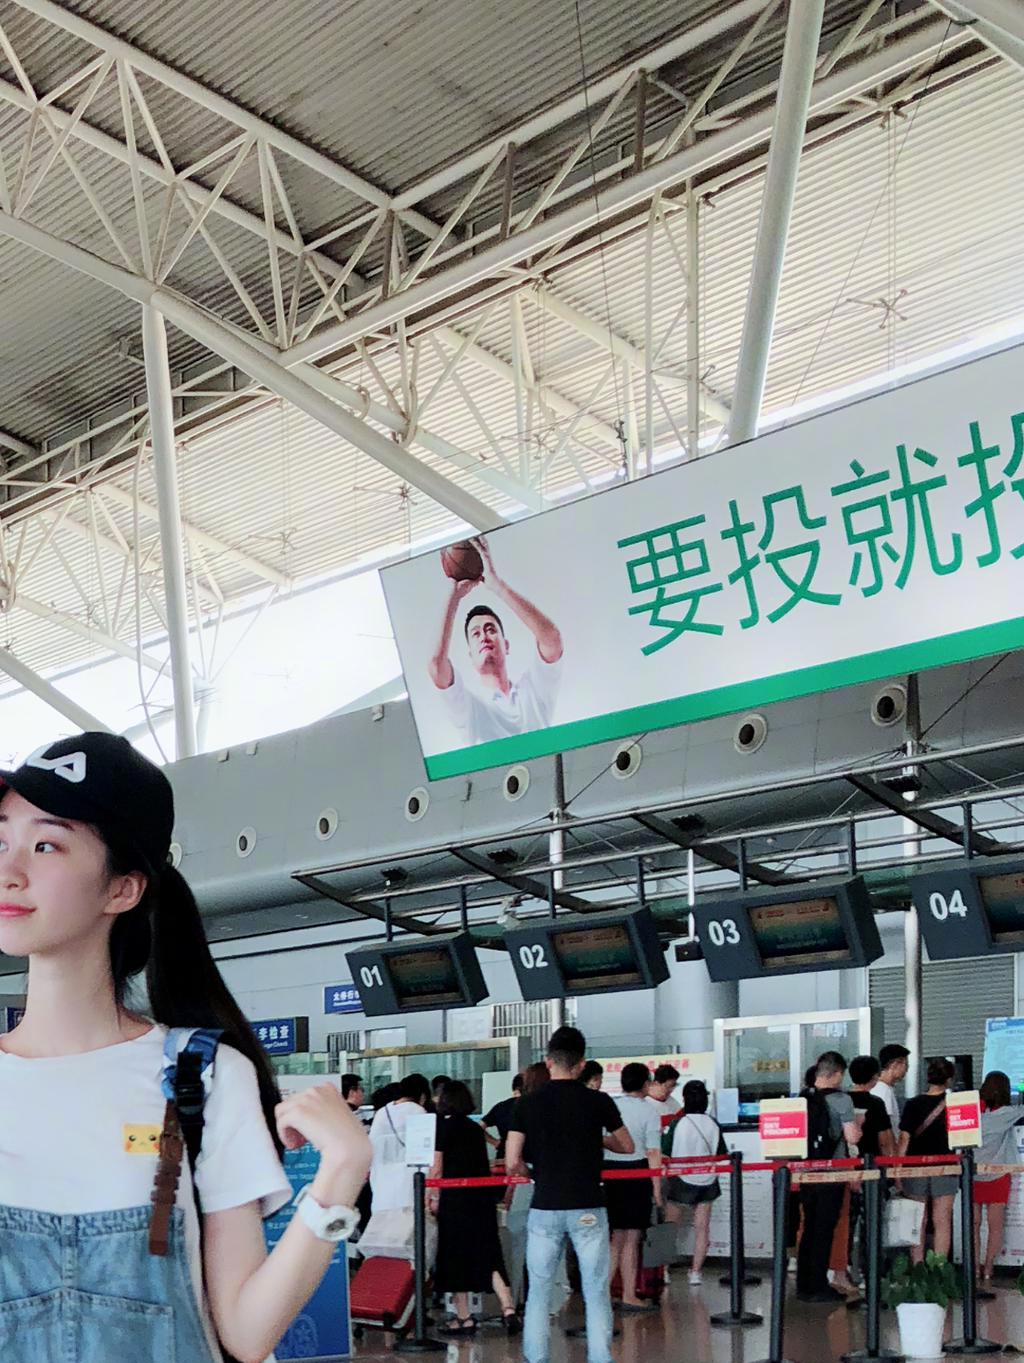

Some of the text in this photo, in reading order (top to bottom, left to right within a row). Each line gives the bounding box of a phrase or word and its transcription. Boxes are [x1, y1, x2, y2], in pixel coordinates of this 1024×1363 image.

[929, 889, 968, 921] 04
[708, 919, 741, 946] 03
[519, 944, 549, 969] 02
[360, 965, 384, 988] 01
[251, 1025, 289, 1041] 李检查
